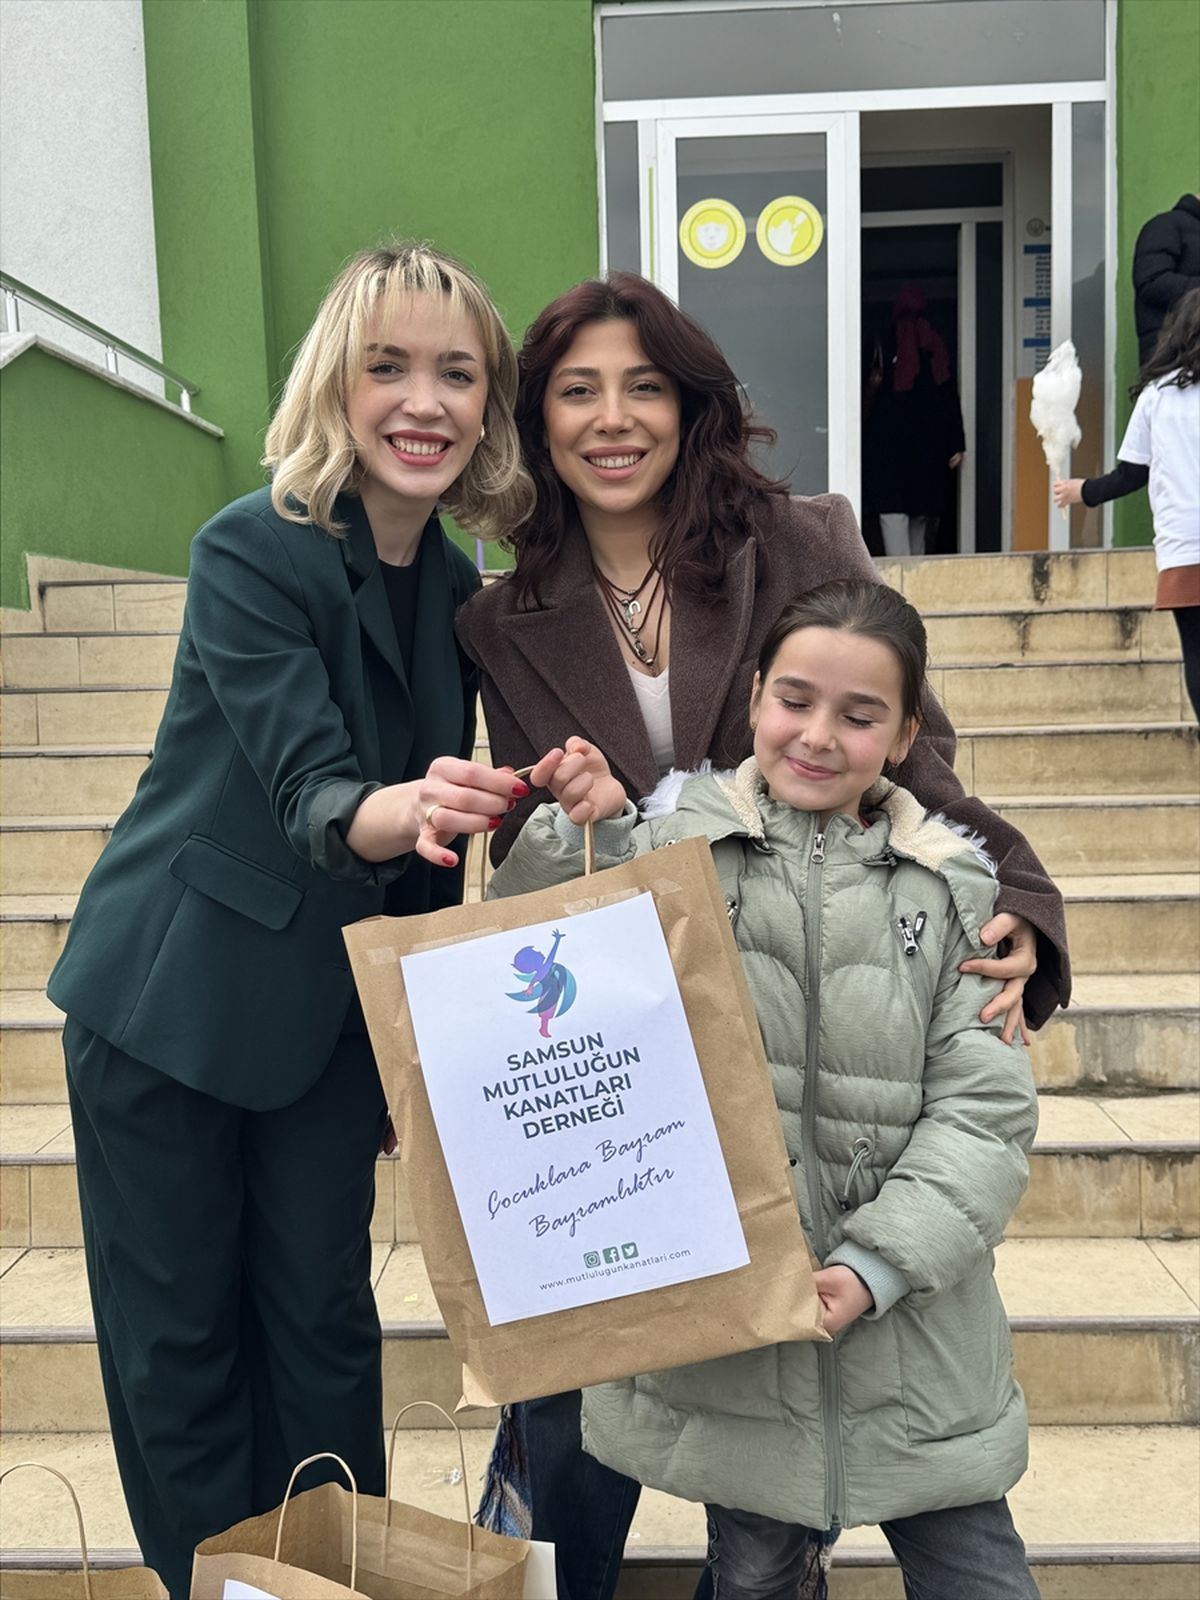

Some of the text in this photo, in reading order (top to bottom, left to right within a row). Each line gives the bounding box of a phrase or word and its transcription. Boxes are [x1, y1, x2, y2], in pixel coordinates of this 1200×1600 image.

[482, 1047, 641, 1102] MUTLULUĞUN
[506, 1032, 605, 1071] SAMSUN
[504, 1073, 633, 1120] KANATLARI
[522, 1094, 625, 1139] DERNEĞİ
[487, 1119, 686, 1220] Çocuklara Bayram
[528, 1167, 675, 1238] Bayramlıktır
[538, 1248, 692, 1291] www.mutlulugunkanatlari.com
